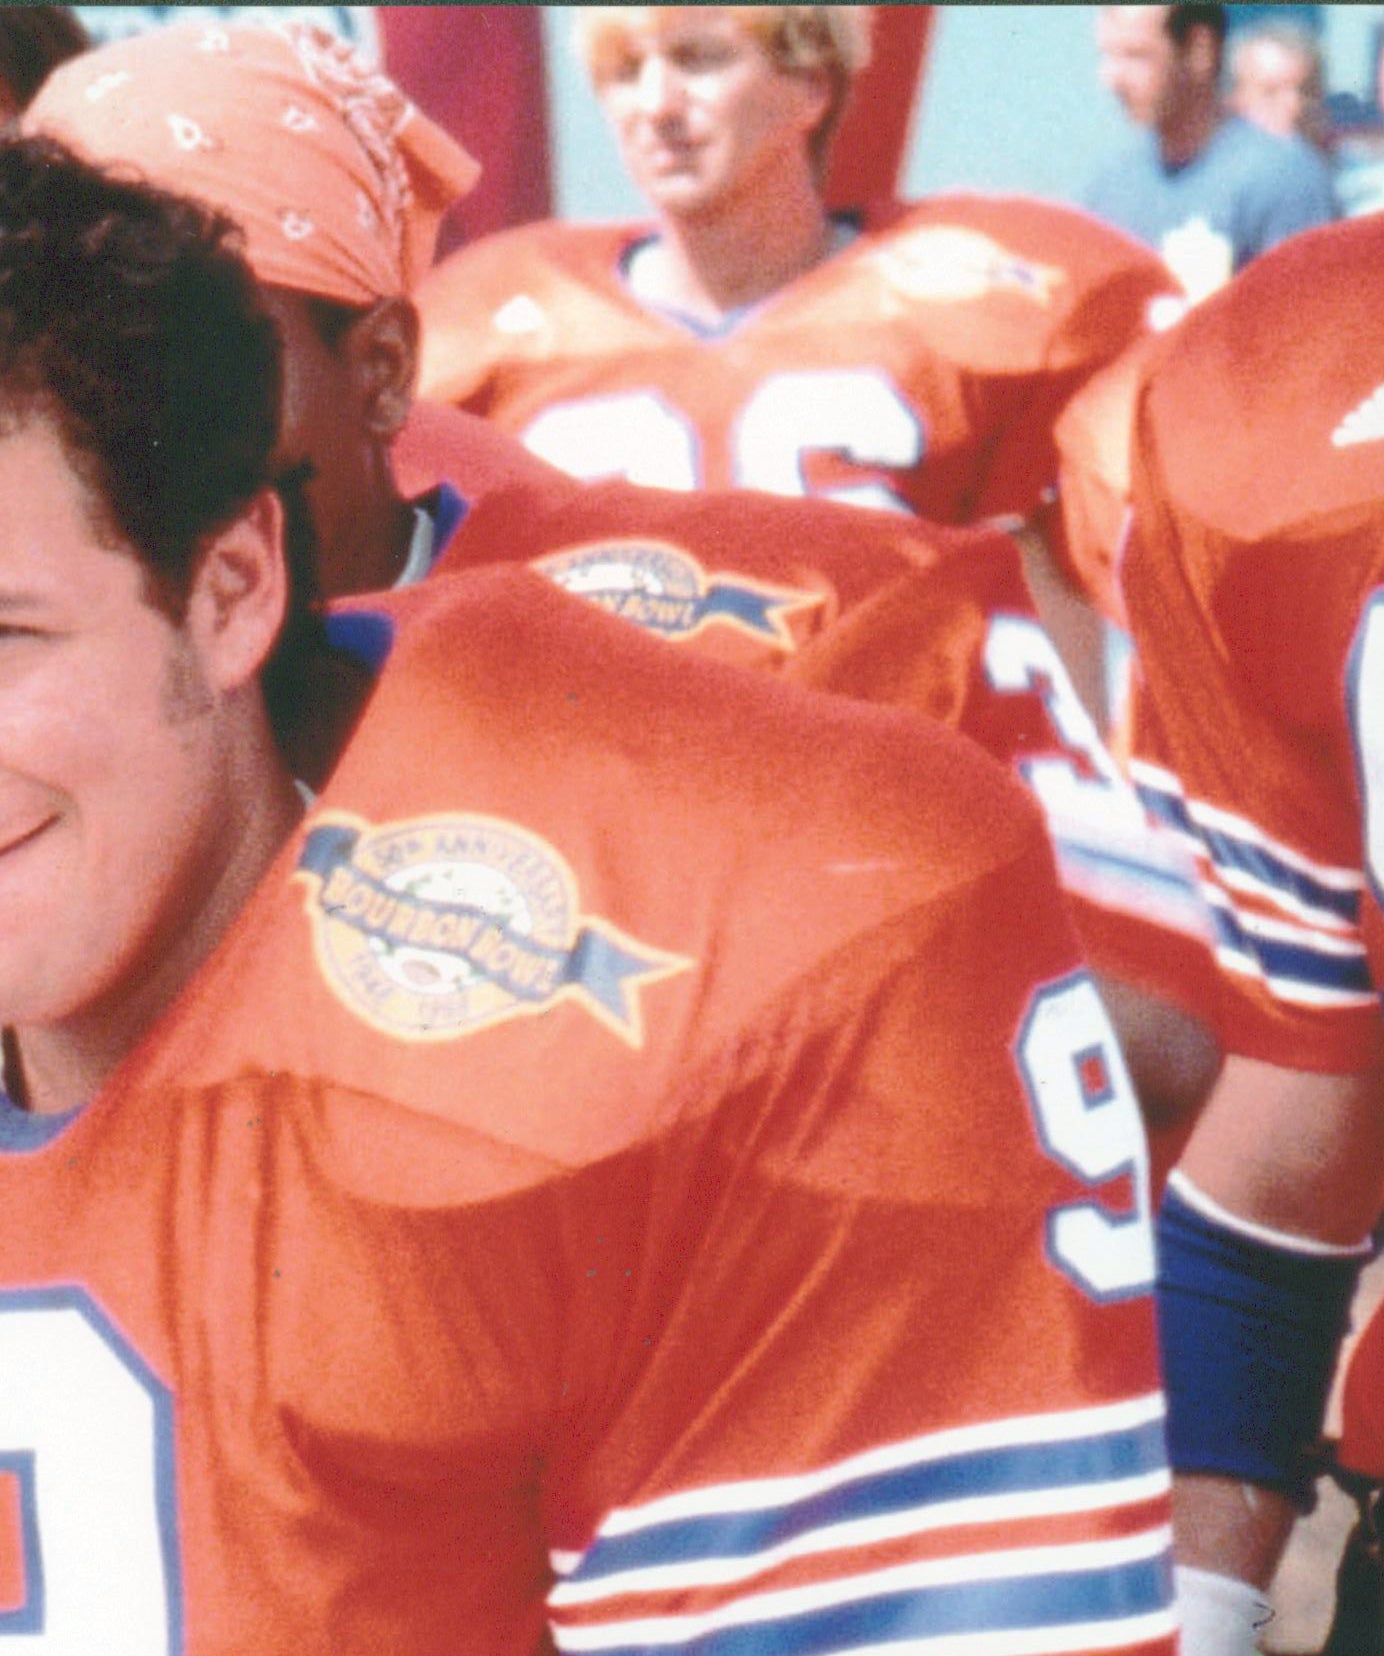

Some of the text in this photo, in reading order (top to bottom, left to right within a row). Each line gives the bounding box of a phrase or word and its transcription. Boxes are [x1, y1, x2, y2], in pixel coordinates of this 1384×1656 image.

[322, 866, 483, 950] BOURBON
[468, 925, 561, 994] BOWL
[1010, 965, 1158, 1302] 9
